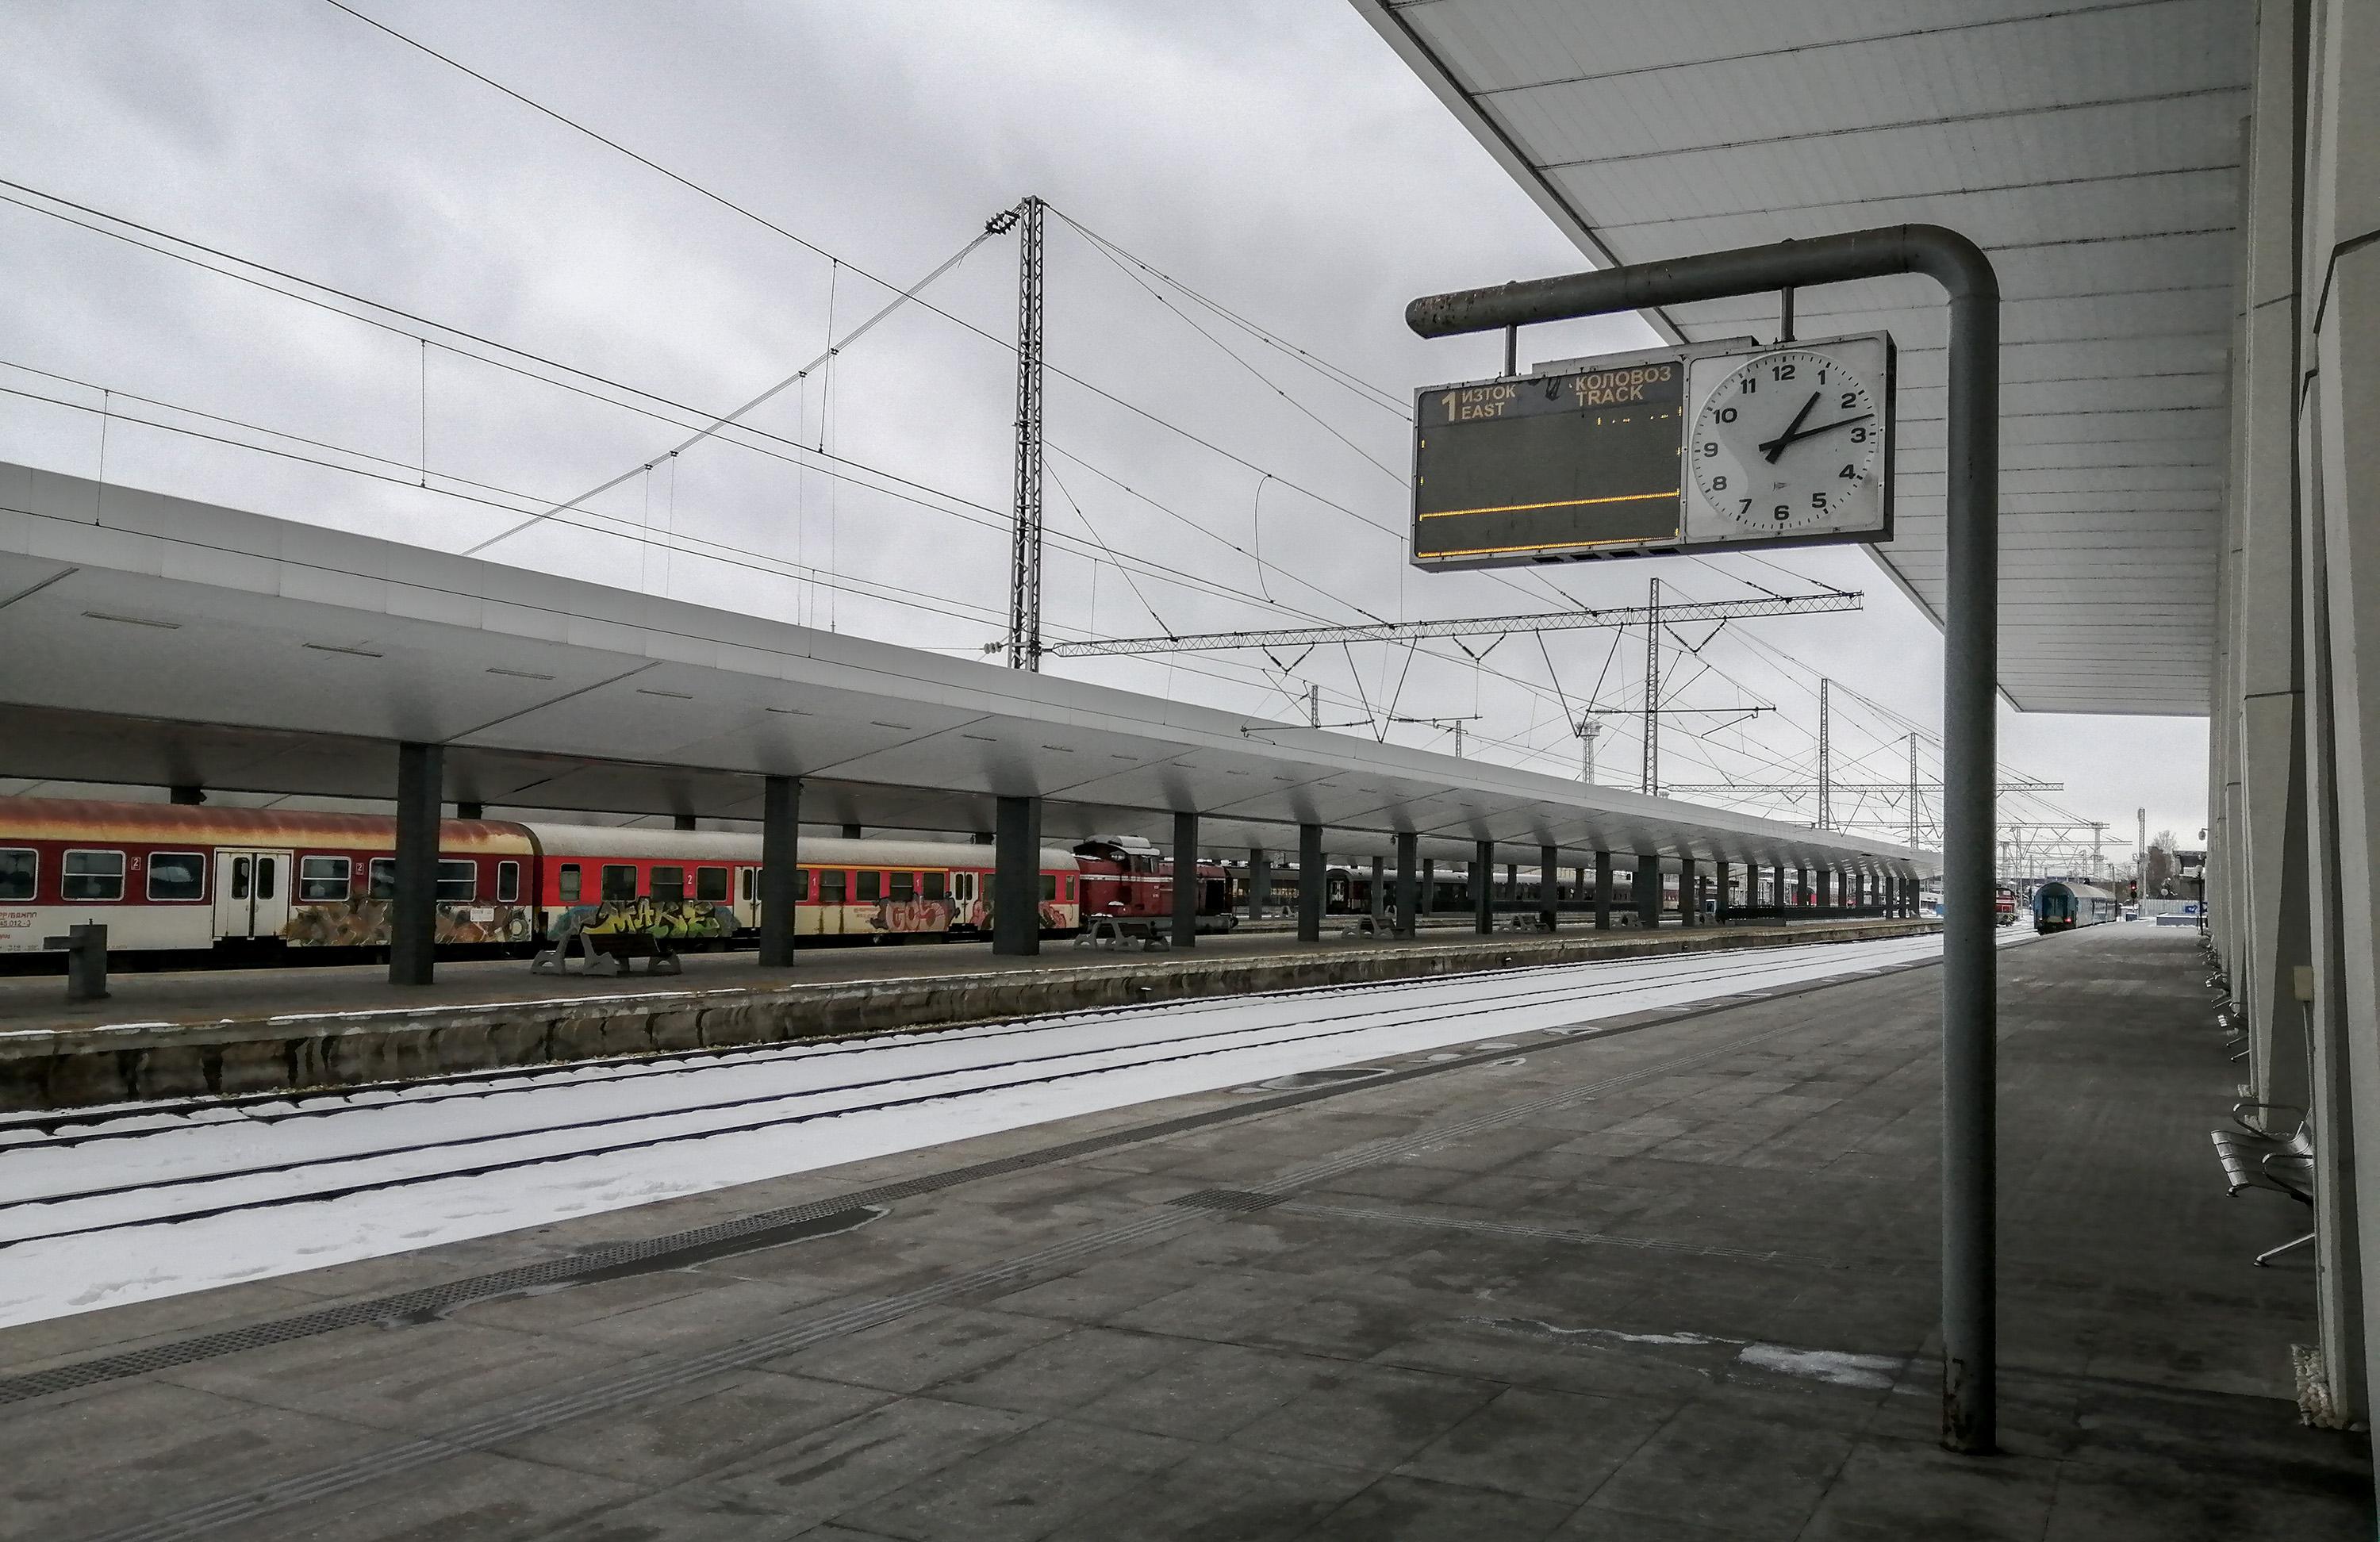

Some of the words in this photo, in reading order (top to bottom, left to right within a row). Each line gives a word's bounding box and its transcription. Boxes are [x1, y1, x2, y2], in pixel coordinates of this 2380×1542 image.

[1576, 366, 1672, 391] КОЛОВОЗ
[1772, 364, 1795, 381] 12
[1818, 370, 1825, 385] 1
[1741, 378, 1756, 393] 11
[1462, 384, 1516, 403] ИЗТОК
[1576, 384, 1644, 407] TRACK
[1841, 393, 1856, 409] 2
[1441, 391, 1456, 422] 1
[1461, 401, 1505, 420] EAST
[1714, 408, 1737, 424] 10
[1850, 428, 1866, 443] 3
[1704, 443, 1718, 457] 9
[1839, 464, 1856, 479] 4
[1713, 476, 1727, 491] 8
[1739, 499, 1752, 514] 7
[1812, 493, 1826, 508] 5
[1774, 505, 1789, 520] 6
[133, 857, 140, 869] 2
[357, 863, 363, 872] 2
[687, 875, 693, 884] 2
[812, 877, 816, 886] 1
